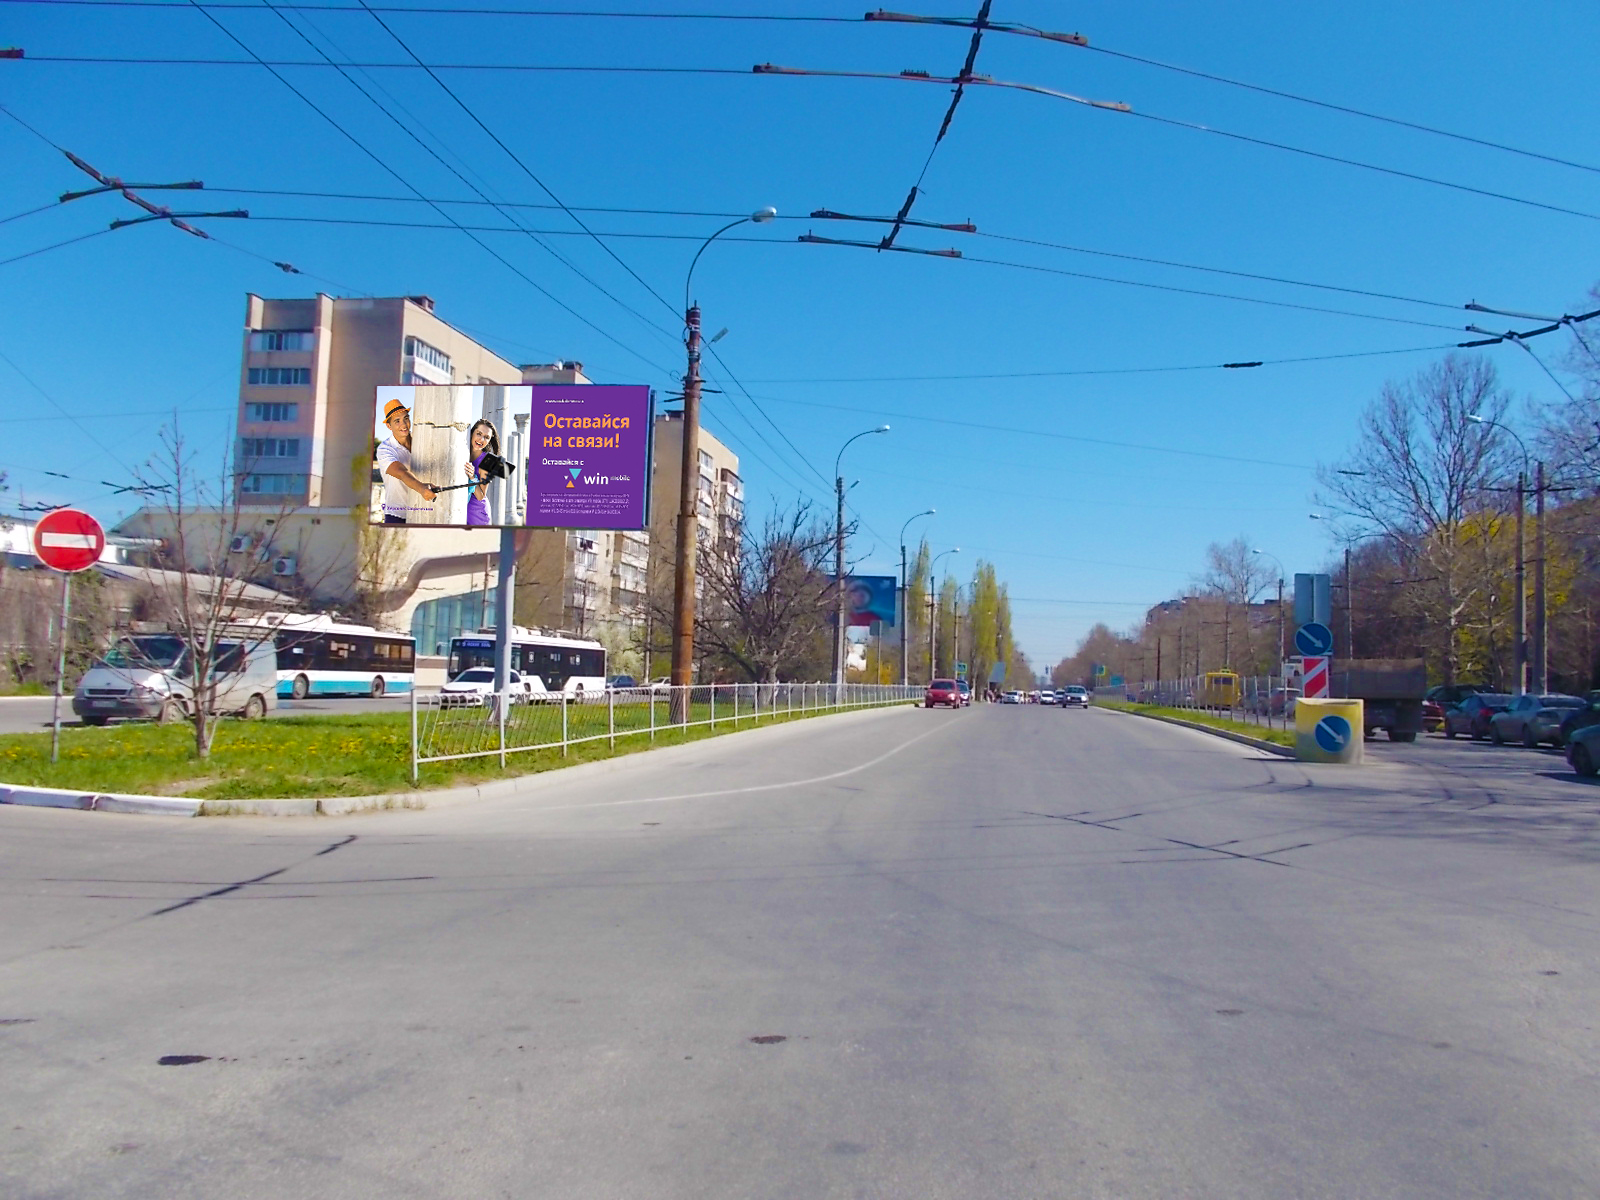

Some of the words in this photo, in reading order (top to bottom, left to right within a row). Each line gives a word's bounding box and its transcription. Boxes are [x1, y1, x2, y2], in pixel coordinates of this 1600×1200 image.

[544, 413, 630, 429] Оставайся
[543, 436, 562, 448] на
[567, 433, 620, 448] связи!
[583, 472, 609, 485] win
